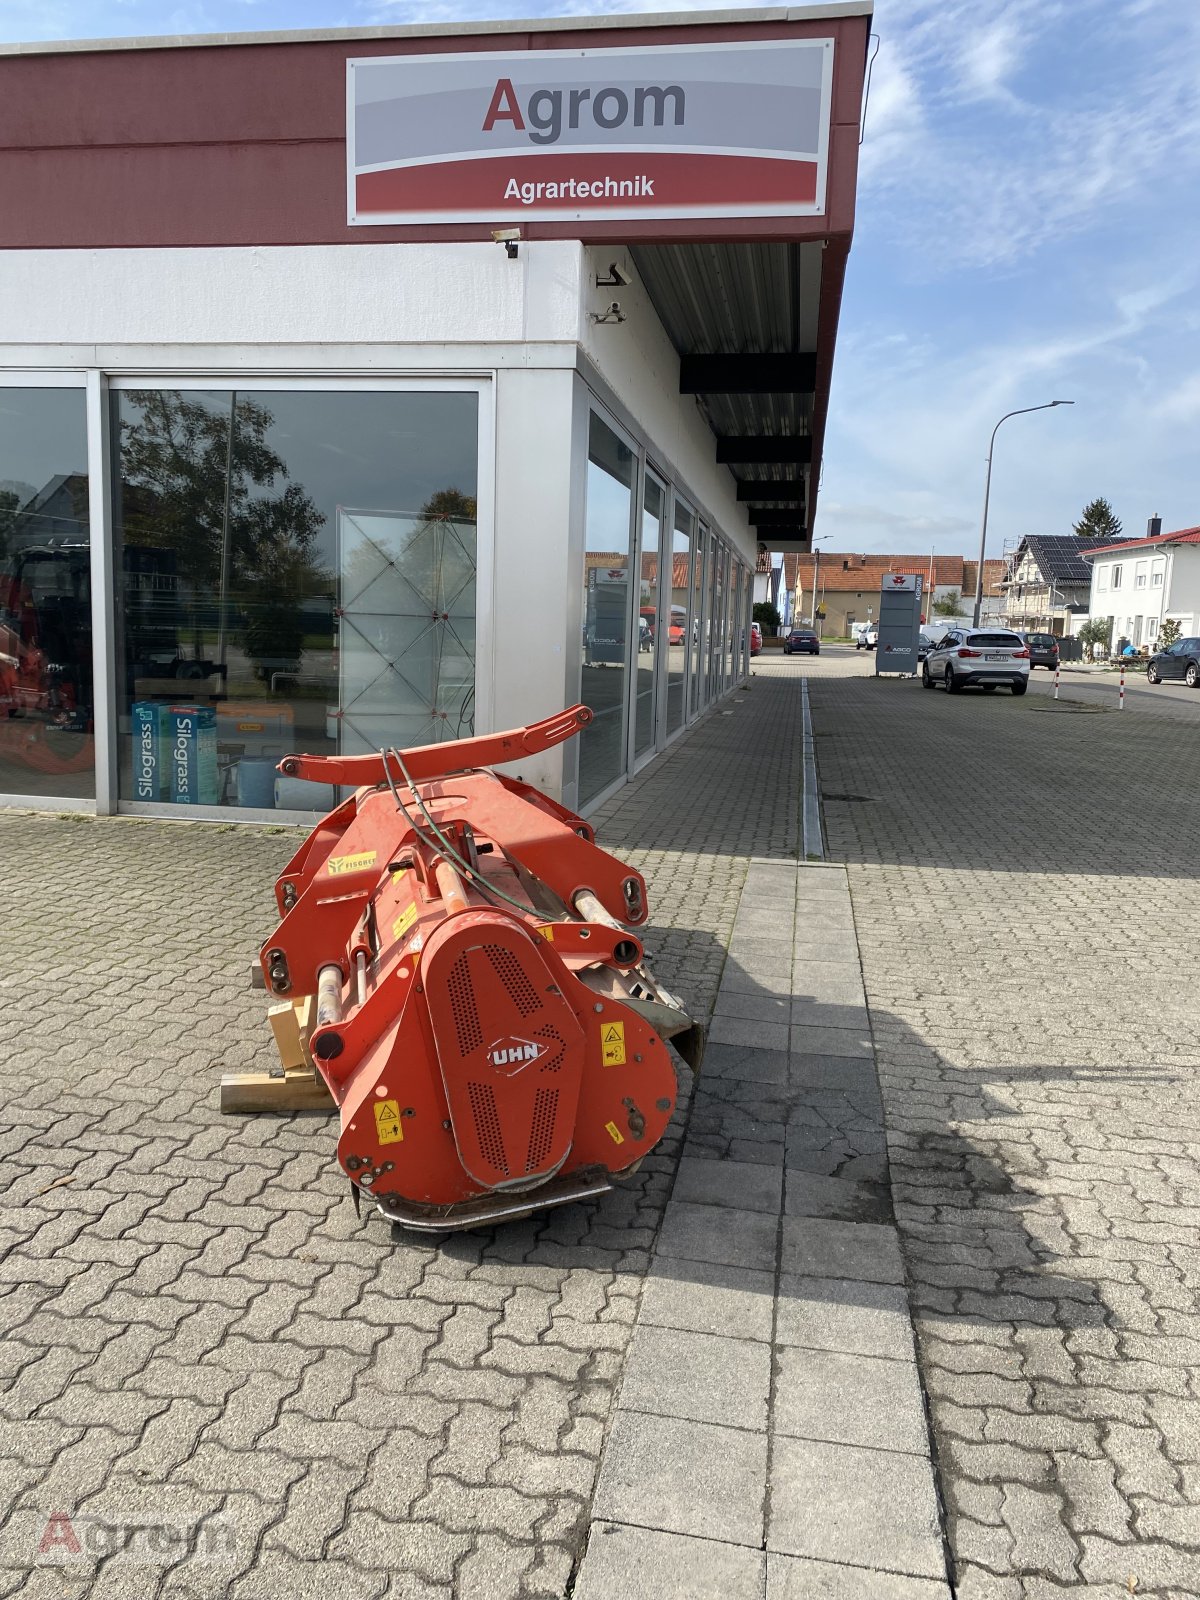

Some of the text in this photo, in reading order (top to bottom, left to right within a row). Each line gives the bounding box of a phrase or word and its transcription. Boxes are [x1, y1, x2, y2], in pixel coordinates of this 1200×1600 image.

[481, 78, 686, 145] Agrom
[503, 176, 655, 203] Agrartechnik
[138, 723, 156, 798] Silograss
[173, 718, 192, 793] Silograss
[488, 1044, 539, 1066] UHN
